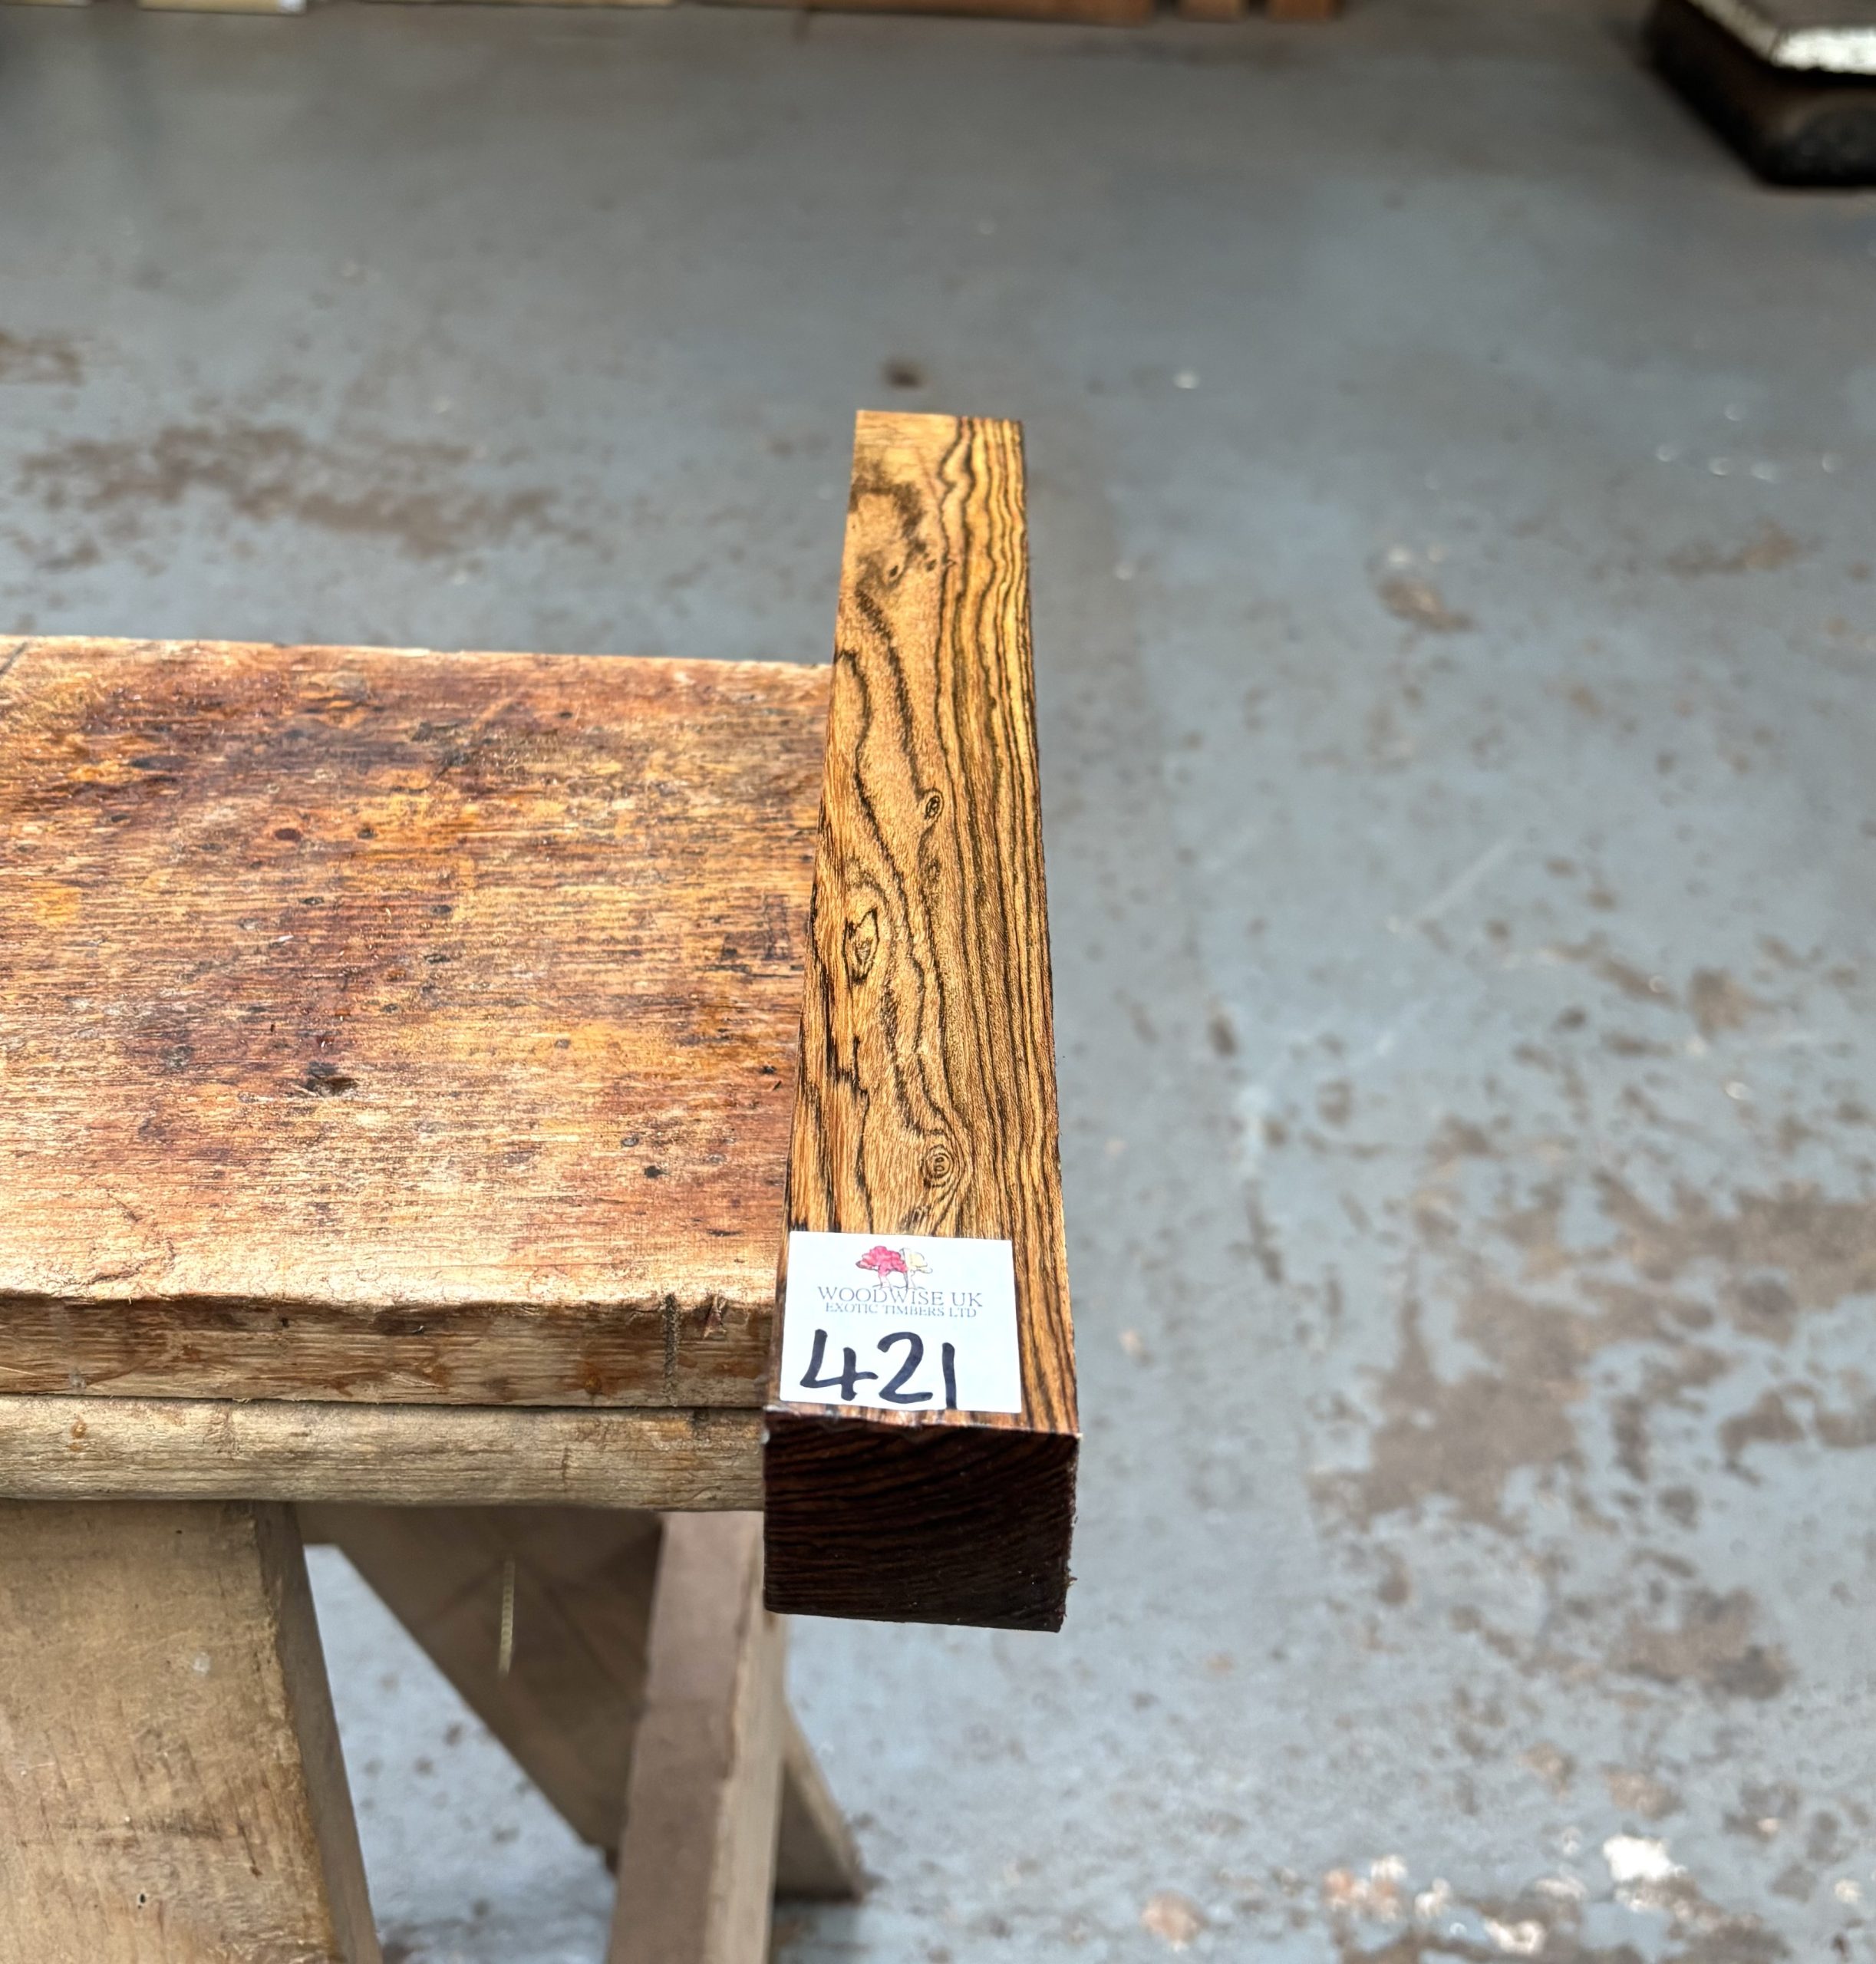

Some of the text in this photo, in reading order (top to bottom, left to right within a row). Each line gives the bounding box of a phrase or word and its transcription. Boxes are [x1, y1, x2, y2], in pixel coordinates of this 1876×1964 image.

[817, 1287, 983, 1307] WOODWISE UK
[826, 1302, 977, 1318] EXOTIC TIMBERS LTD
[800, 1329, 958, 1409] 421
